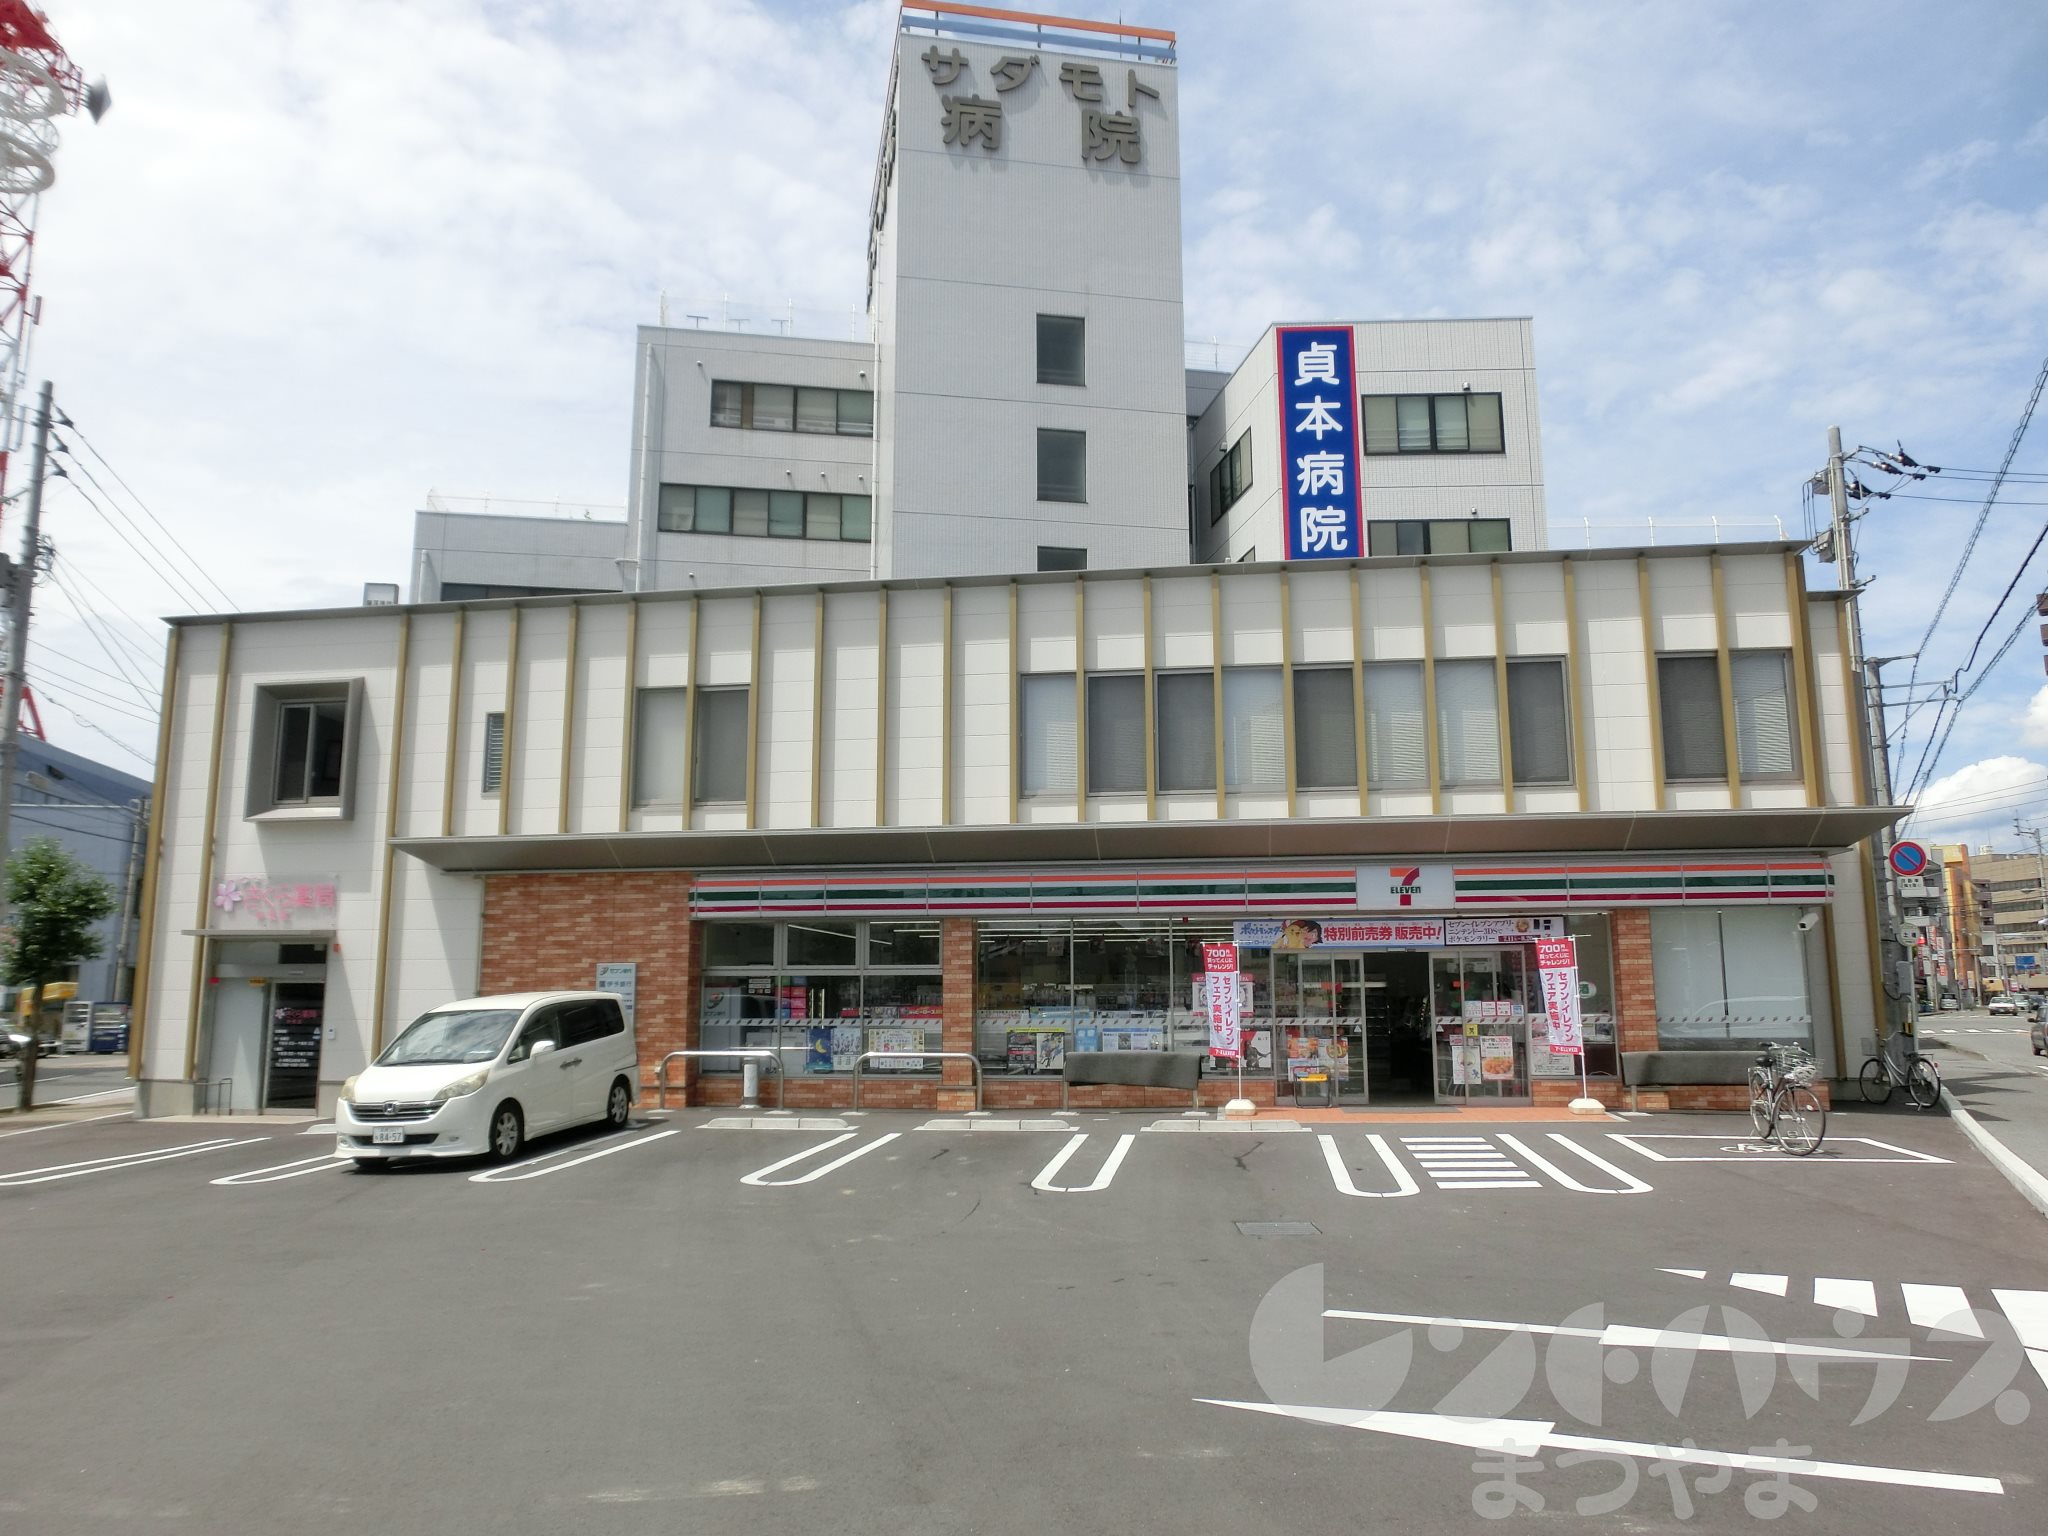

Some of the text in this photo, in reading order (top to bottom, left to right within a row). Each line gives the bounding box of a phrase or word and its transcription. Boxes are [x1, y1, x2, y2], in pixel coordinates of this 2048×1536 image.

[921, 45, 1160, 108] サダモト
[941, 93, 1142, 164] 病院
[1294, 341, 1348, 553] 貞本病院
[1323, 926, 1393, 941] 特別前売券
[1448, 934, 1496, 943] ポケモンラリー
[1212, 976, 1223, 1034] フェア実施中
[1545, 972, 1561, 1030] フェア実施中
